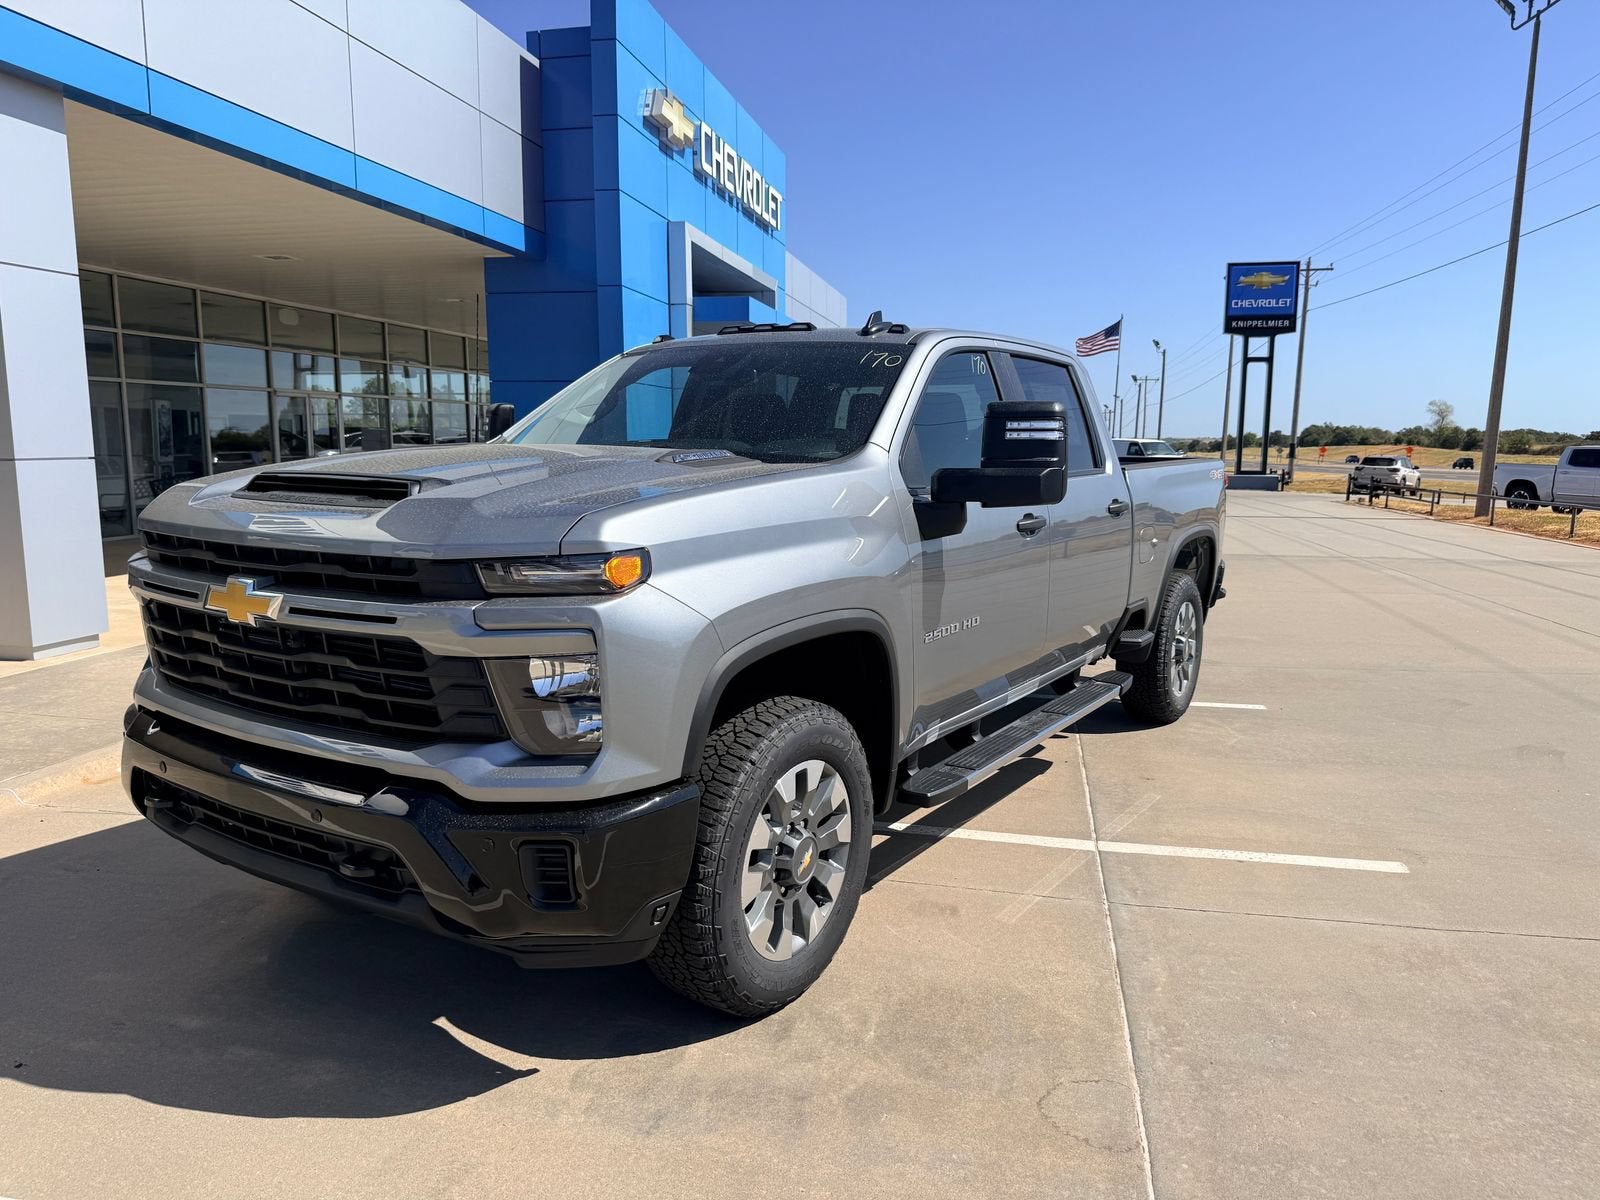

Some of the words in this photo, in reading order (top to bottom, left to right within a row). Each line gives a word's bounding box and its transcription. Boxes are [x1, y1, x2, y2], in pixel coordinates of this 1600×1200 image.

[700, 121, 783, 231] CHEVROLET
[1231, 298, 1291, 307] CHEVROLET
[1231, 320, 1289, 328] KNIPPELMIER
[859, 350, 902, 368] 170
[970, 354, 987, 375] 170
[924, 622, 960, 644] 2500
[962, 616, 981, 630] HD
